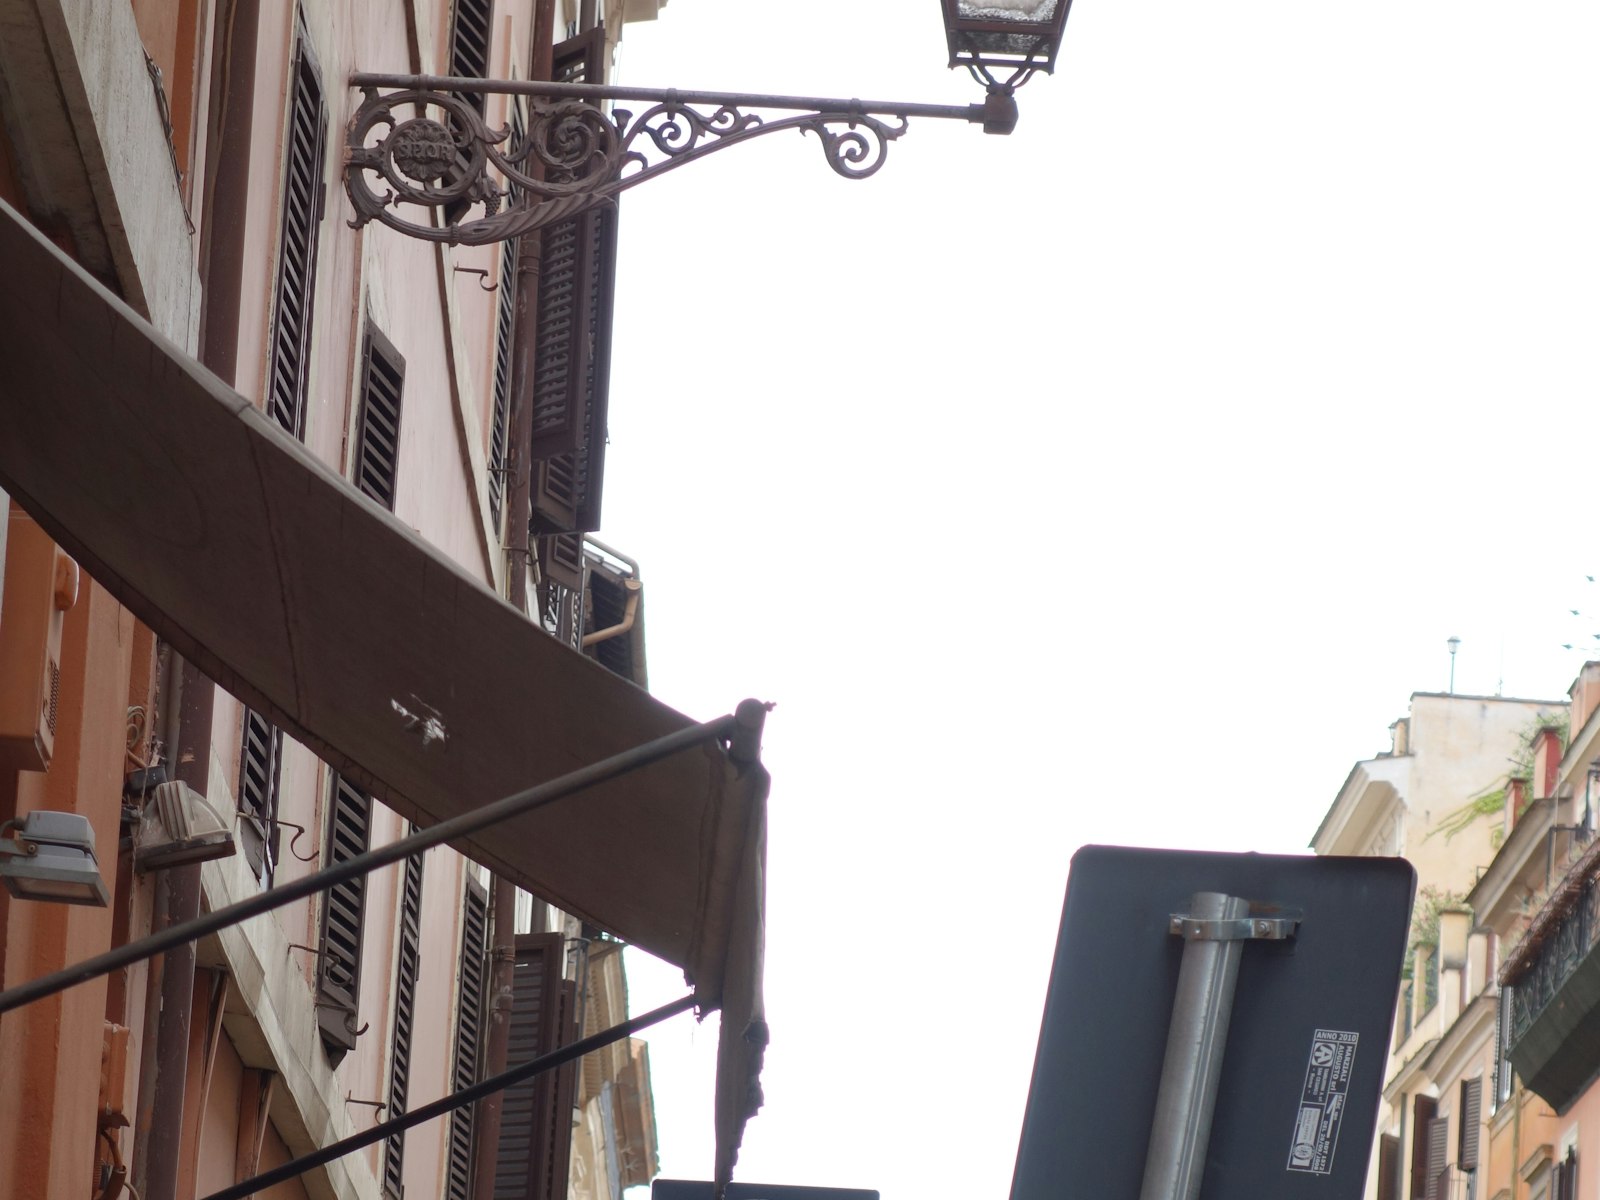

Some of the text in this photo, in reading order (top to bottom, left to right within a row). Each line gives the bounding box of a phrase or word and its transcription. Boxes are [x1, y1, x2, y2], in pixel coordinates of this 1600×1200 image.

[398, 142, 448, 160] SPQR
[1317, 1032, 1357, 1042] ANNO 2010
[1332, 1044, 1345, 1079] AUGUSTO
[1320, 1120, 1328, 1132] DEL
